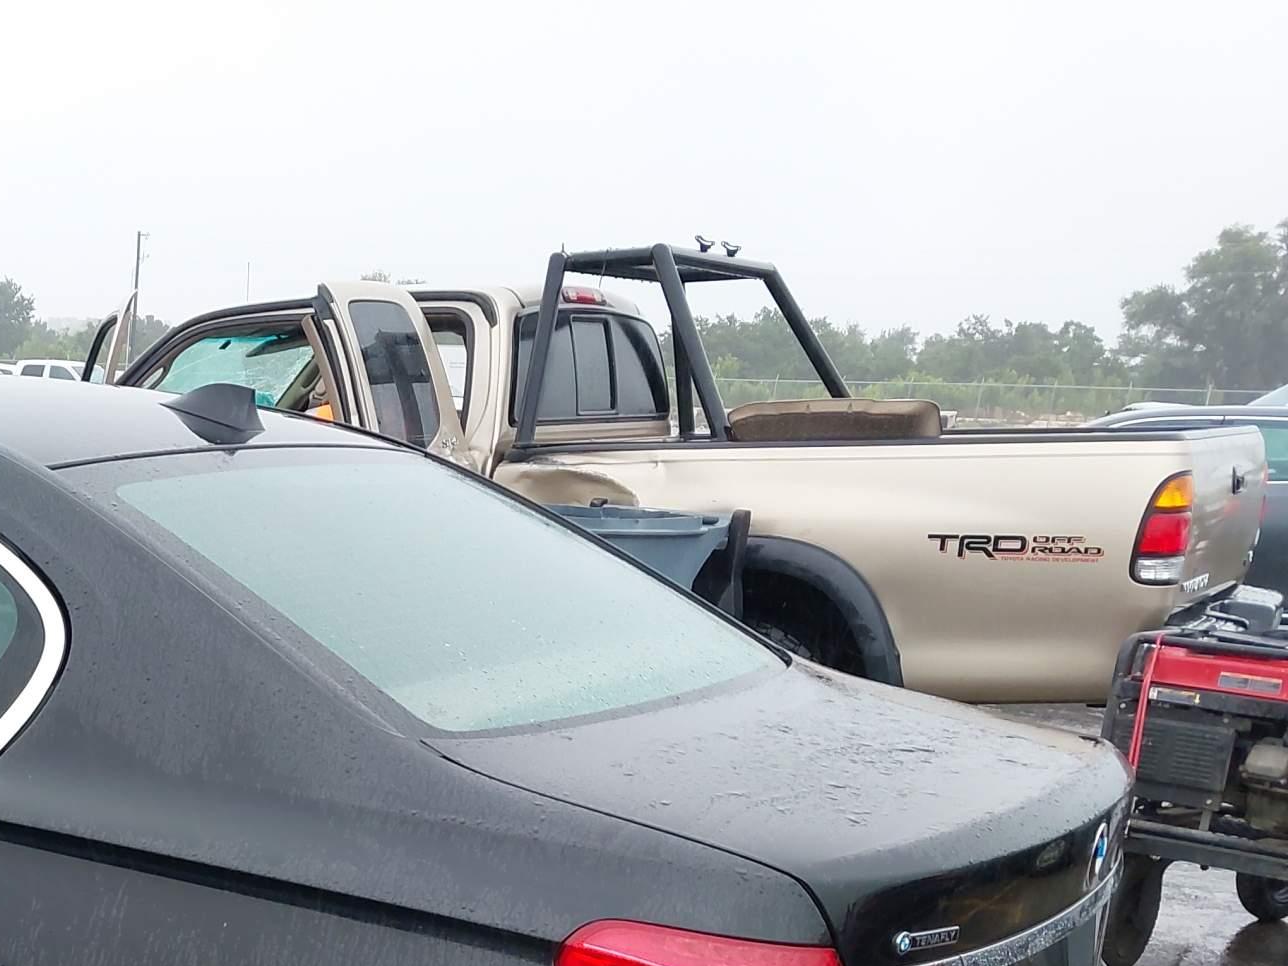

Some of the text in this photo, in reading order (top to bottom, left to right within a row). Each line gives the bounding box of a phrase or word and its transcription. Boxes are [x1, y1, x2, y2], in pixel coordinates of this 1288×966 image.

[927, 533, 1028, 560] TRD
[1032, 535, 1085, 545] OFF
[1031, 545, 1104, 556] ROAD
[915, 930, 956, 947] TENAFLY
